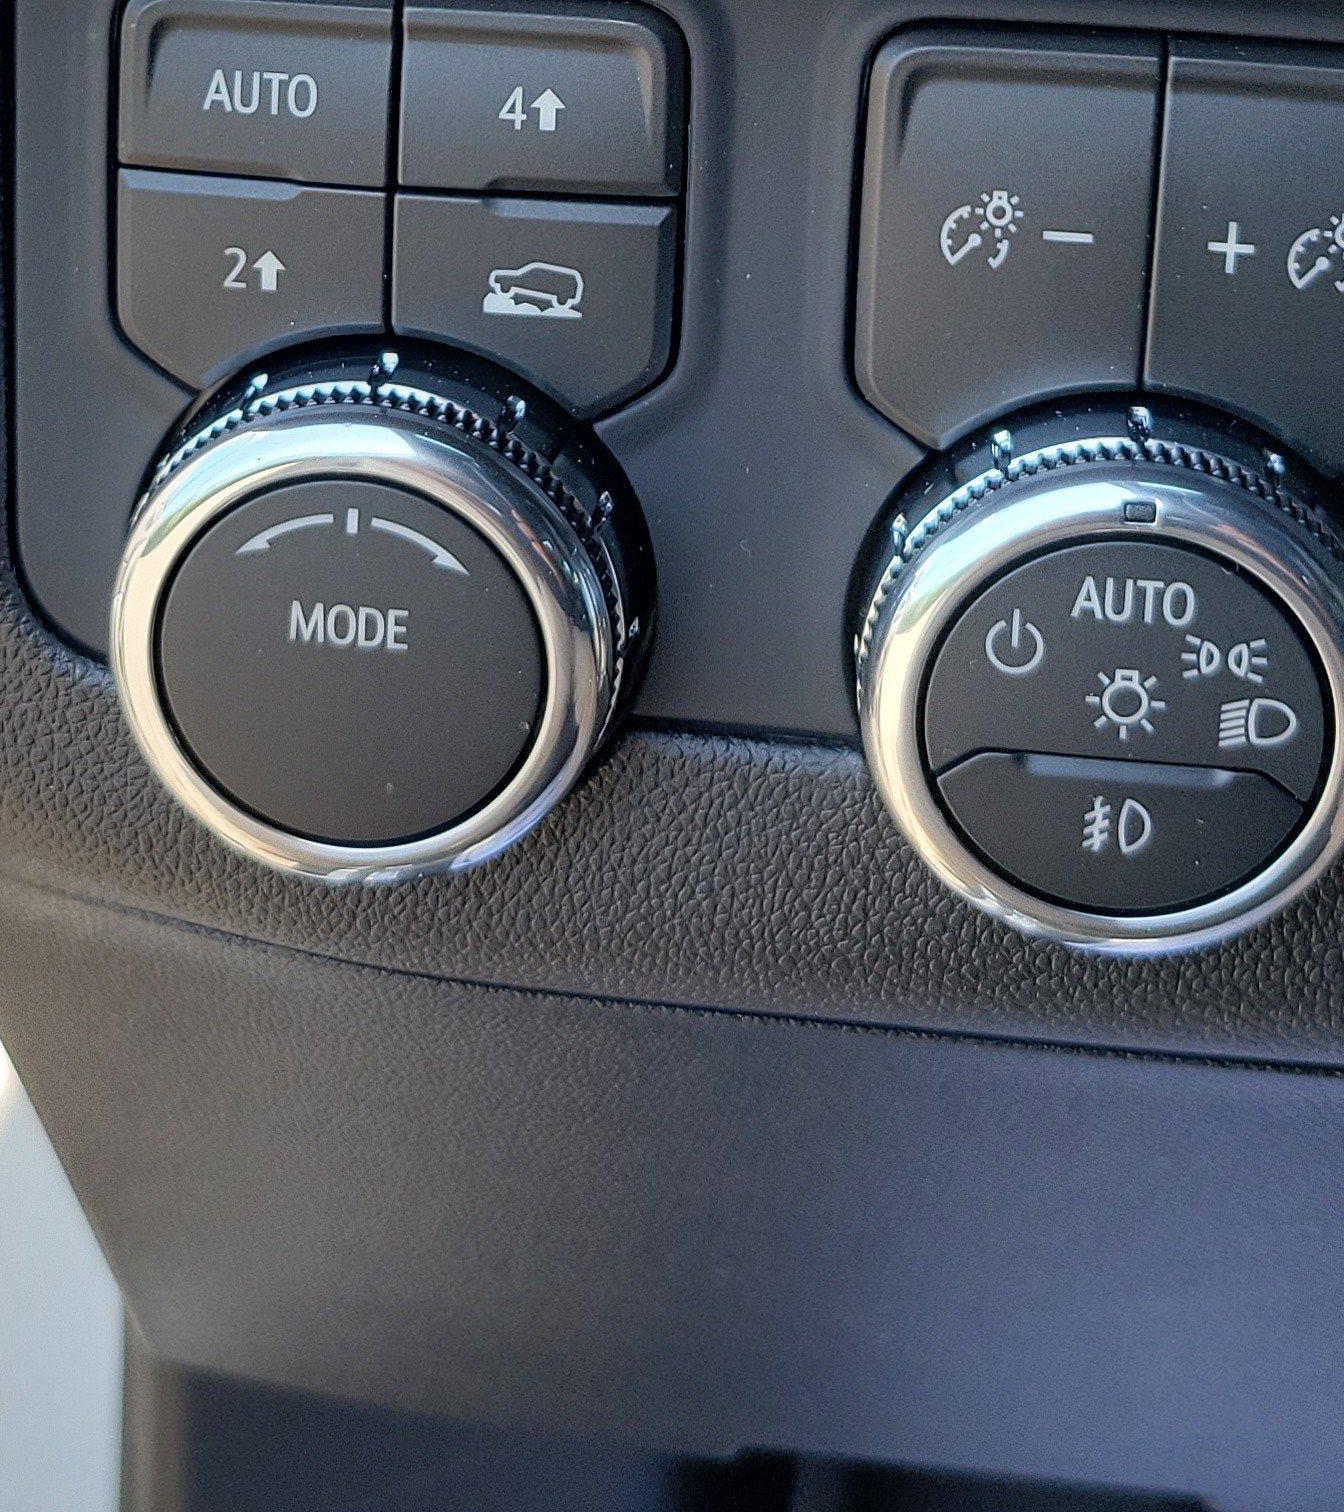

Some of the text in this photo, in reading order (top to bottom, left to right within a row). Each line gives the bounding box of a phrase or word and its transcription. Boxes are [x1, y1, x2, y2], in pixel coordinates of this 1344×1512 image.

[203, 68, 319, 118] AUTO
[498, 85, 528, 131] 4
[222, 247, 248, 290] 2
[288, 599, 410, 651] MODE
[1070, 575, 1196, 627] AUTO
